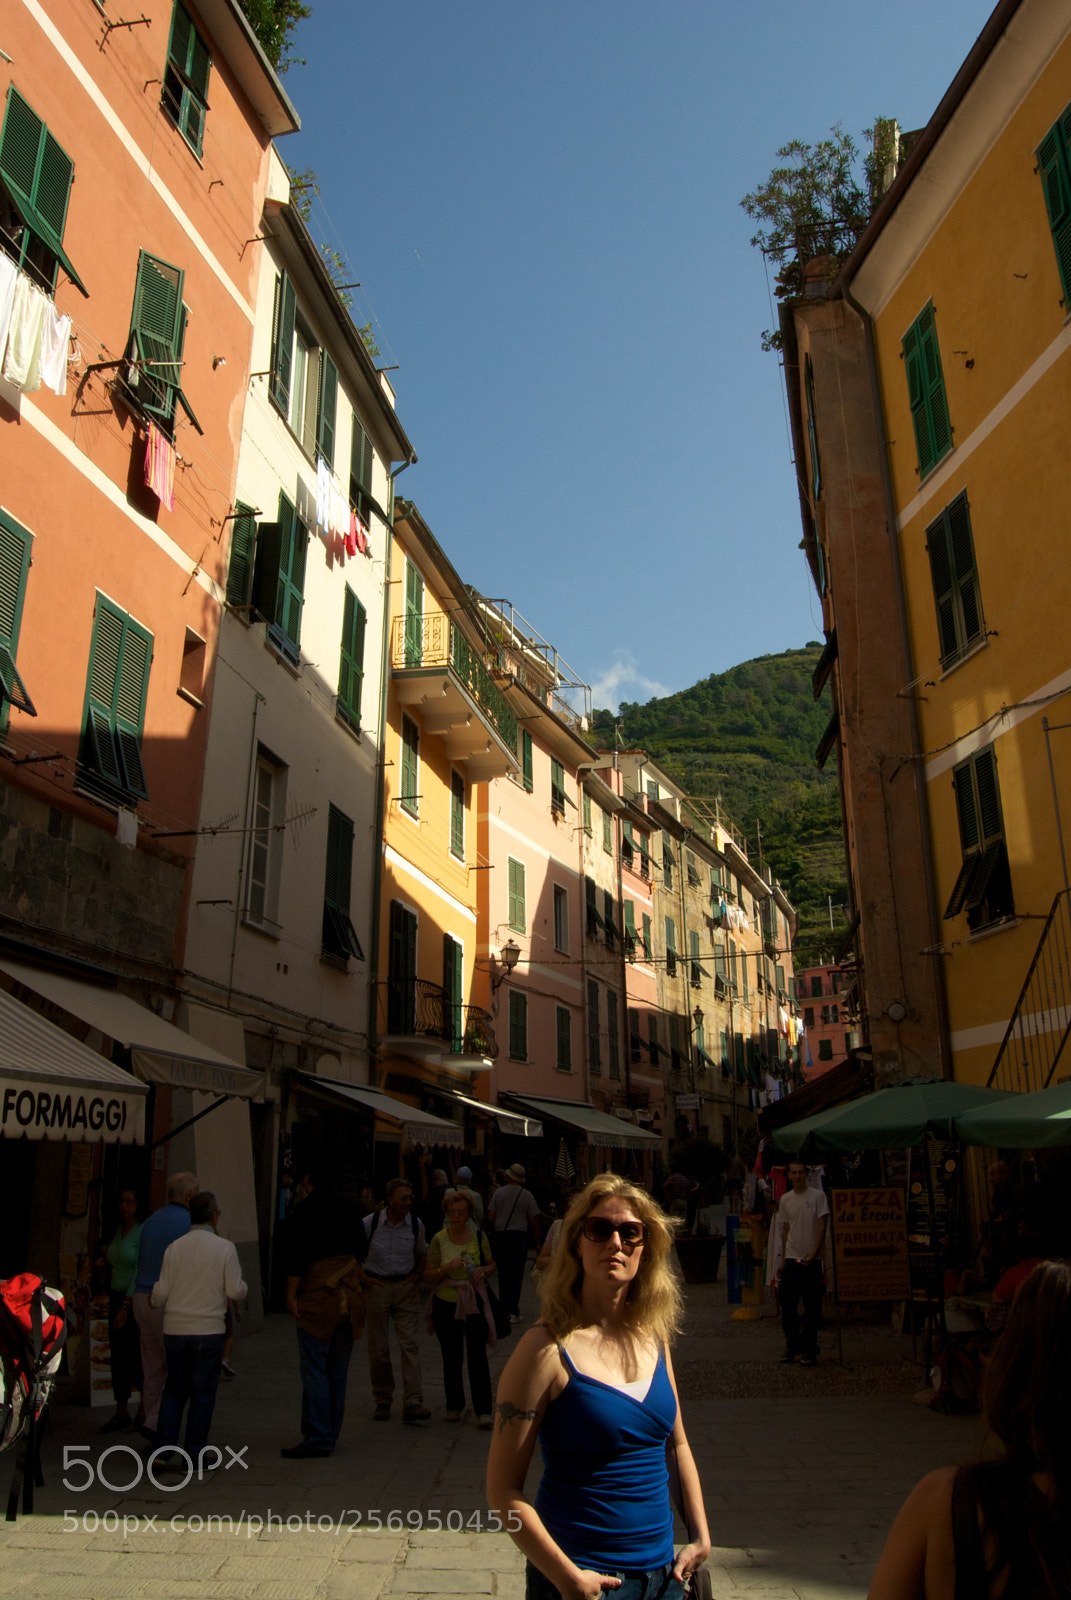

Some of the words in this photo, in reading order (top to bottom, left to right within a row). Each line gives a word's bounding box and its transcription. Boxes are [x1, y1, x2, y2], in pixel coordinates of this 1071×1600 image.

[2, 1088, 126, 1132] FORMAGGI
[835, 1191, 902, 1212] PIZZA
[837, 1210, 855, 1222] da
[836, 1231, 907, 1244] FARINATA
